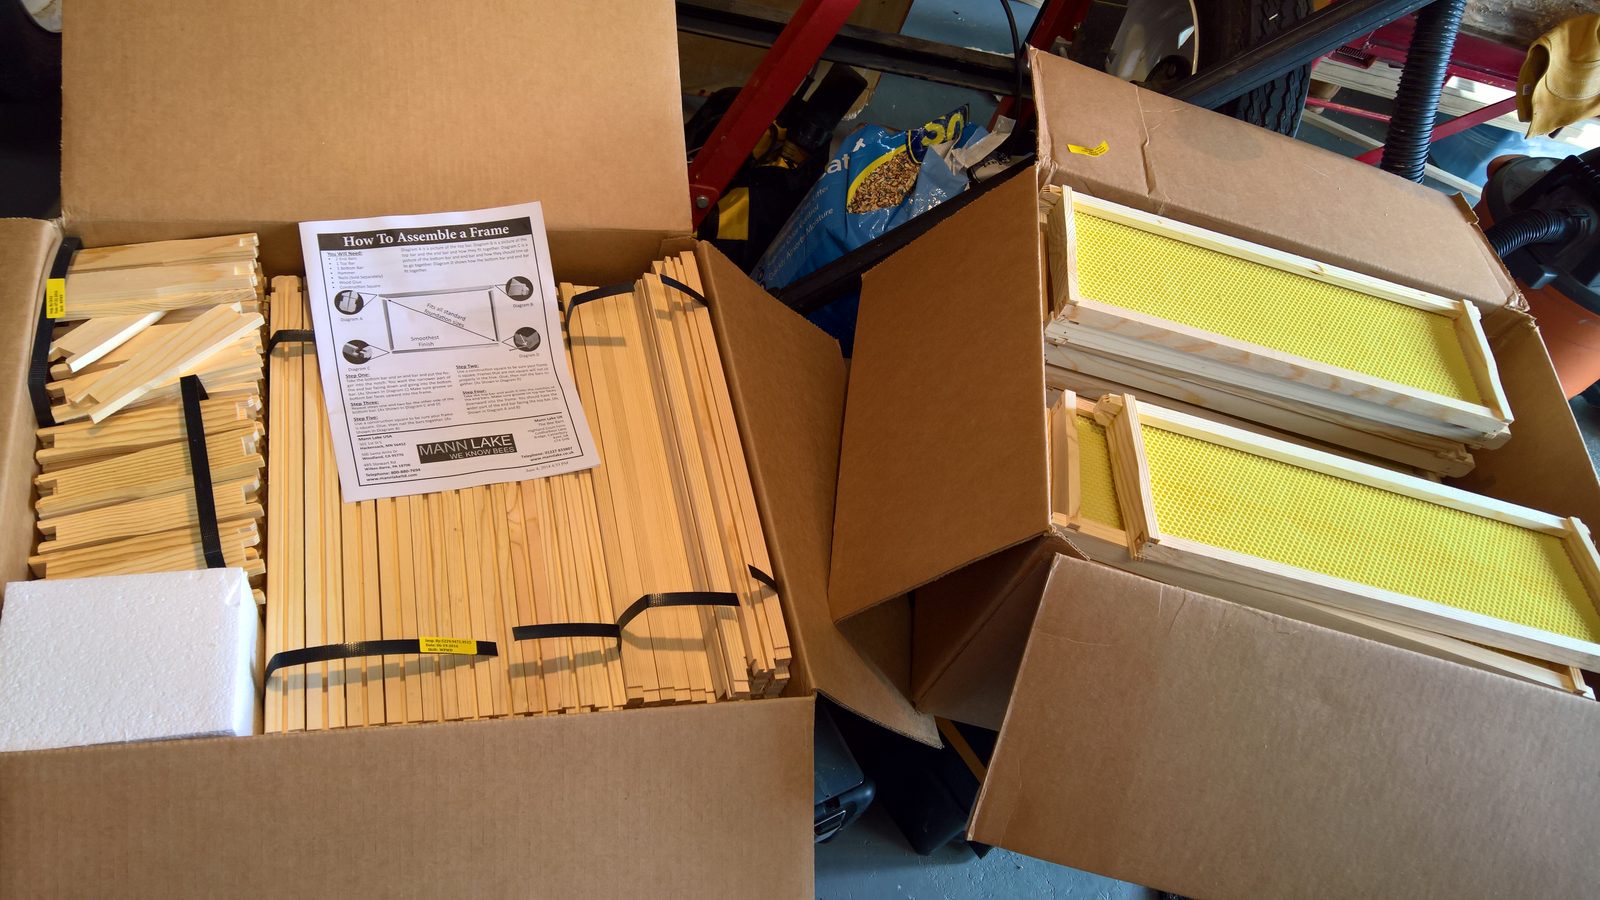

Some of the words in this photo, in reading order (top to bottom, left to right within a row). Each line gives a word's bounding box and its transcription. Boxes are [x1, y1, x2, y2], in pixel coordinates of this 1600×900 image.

[344, 236, 373, 246] How
[377, 234, 393, 243] To
[398, 230, 456, 242] Assemble
[470, 227, 508, 237] Frame
[424, 309, 451, 322] foundation
[444, 310, 466, 321] standard
[420, 441, 467, 455] MANN
[471, 435, 511, 448] LAKE
